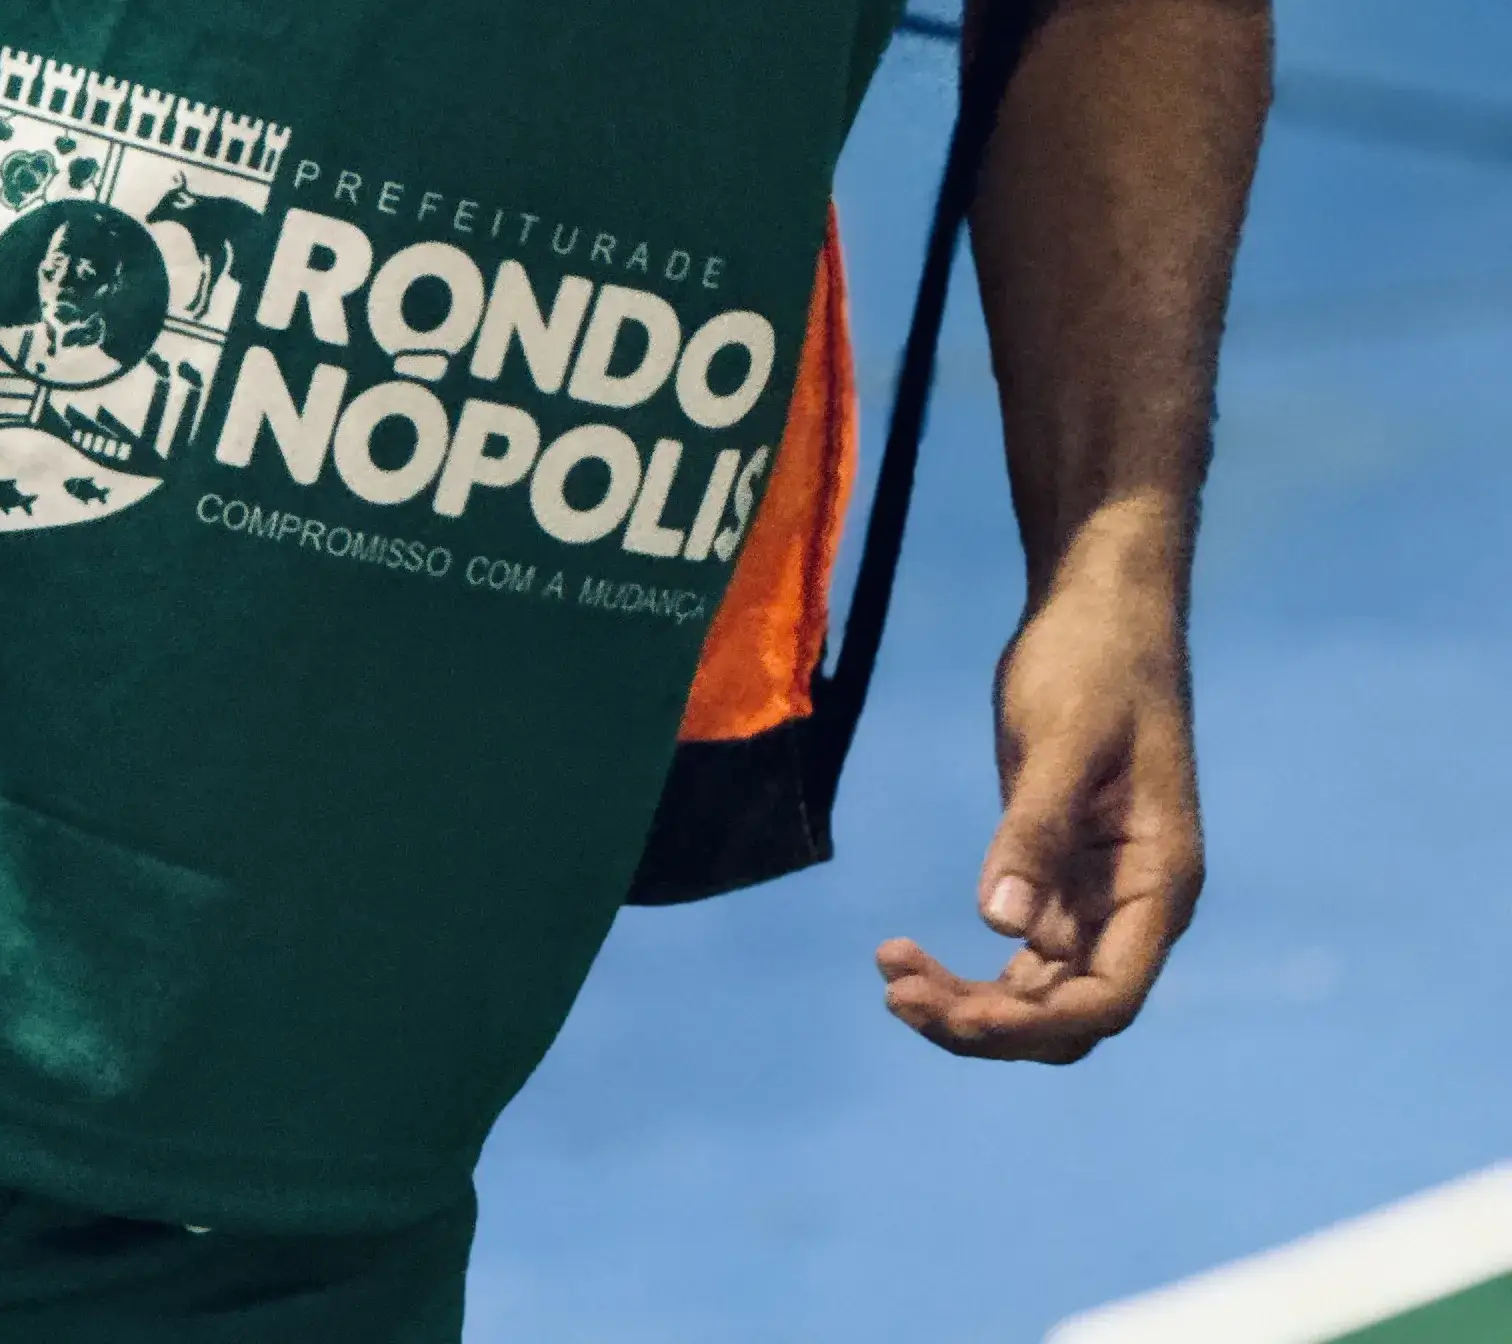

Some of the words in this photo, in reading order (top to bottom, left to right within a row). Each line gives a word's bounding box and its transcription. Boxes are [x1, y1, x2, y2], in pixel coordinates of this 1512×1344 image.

[256, 208, 775, 429] RONDO
[196, 492, 453, 578] COMPROMISSO
[465, 555, 537, 593] COM
[542, 571, 564, 600] A
